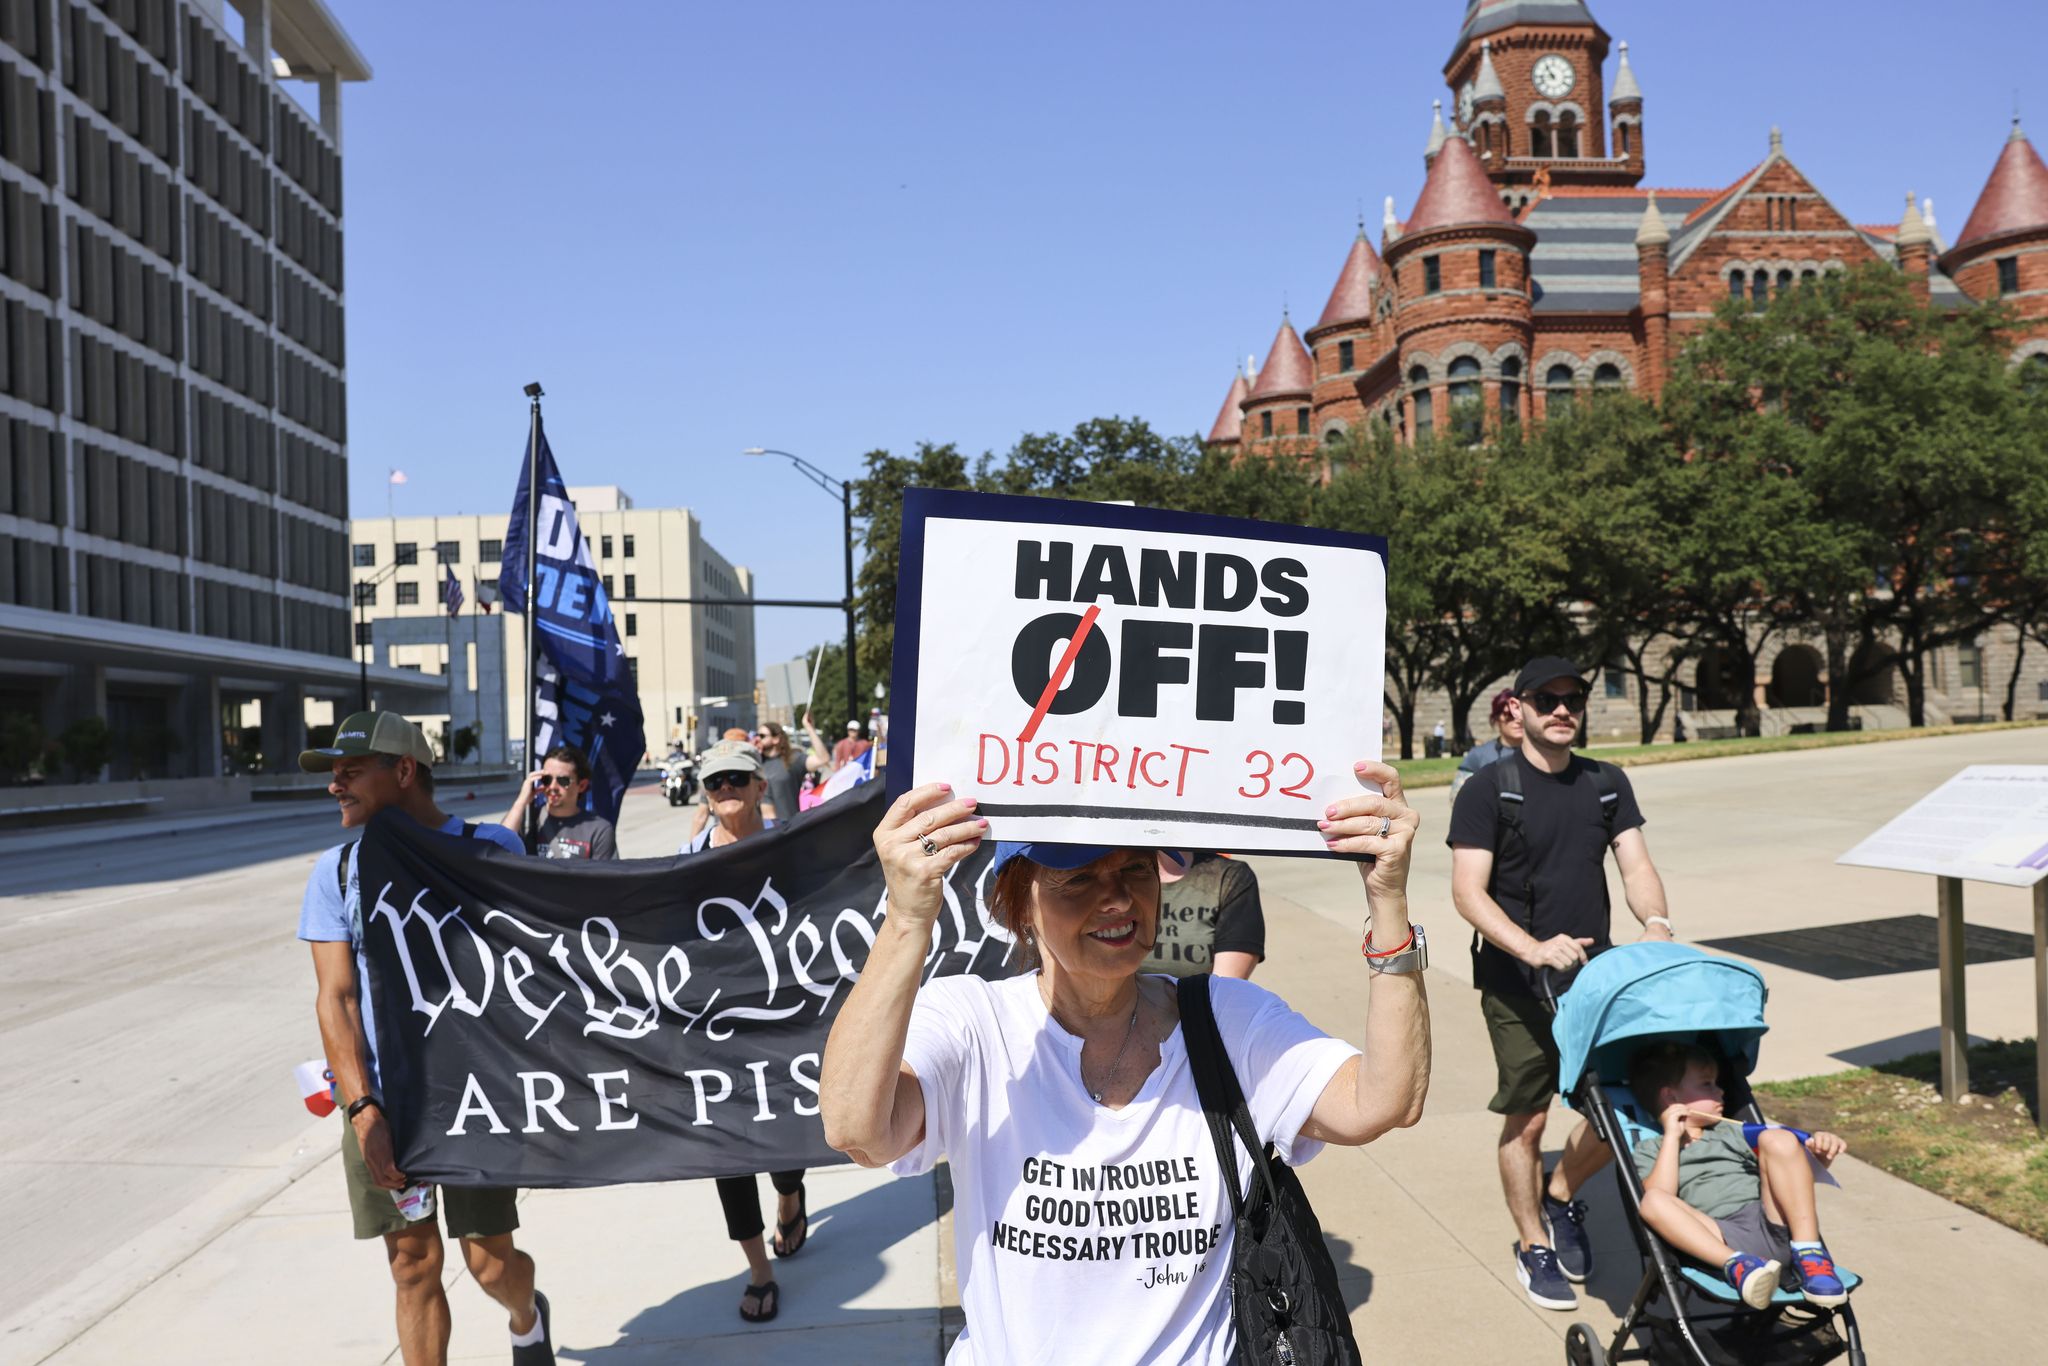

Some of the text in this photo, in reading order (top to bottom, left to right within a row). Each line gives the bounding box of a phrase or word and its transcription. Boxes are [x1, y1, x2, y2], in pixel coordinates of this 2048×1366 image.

[1014, 540, 1309, 617] HANDS
[1011, 612, 1309, 725] OFF!
[976, 733, 1315, 800] DISTRICT 32
[1163, 902, 1220, 923] kers
[369, 881, 567, 1040] We
[446, 1053, 820, 1136] ARE PIS
[1023, 1157, 1065, 1188] GET
[1072, 1167, 1096, 1191] IN
[992, 1221, 1221, 1261] NECESSARY TROUBLE
[1025, 1192, 1199, 1227] GOOD TROUBLE
